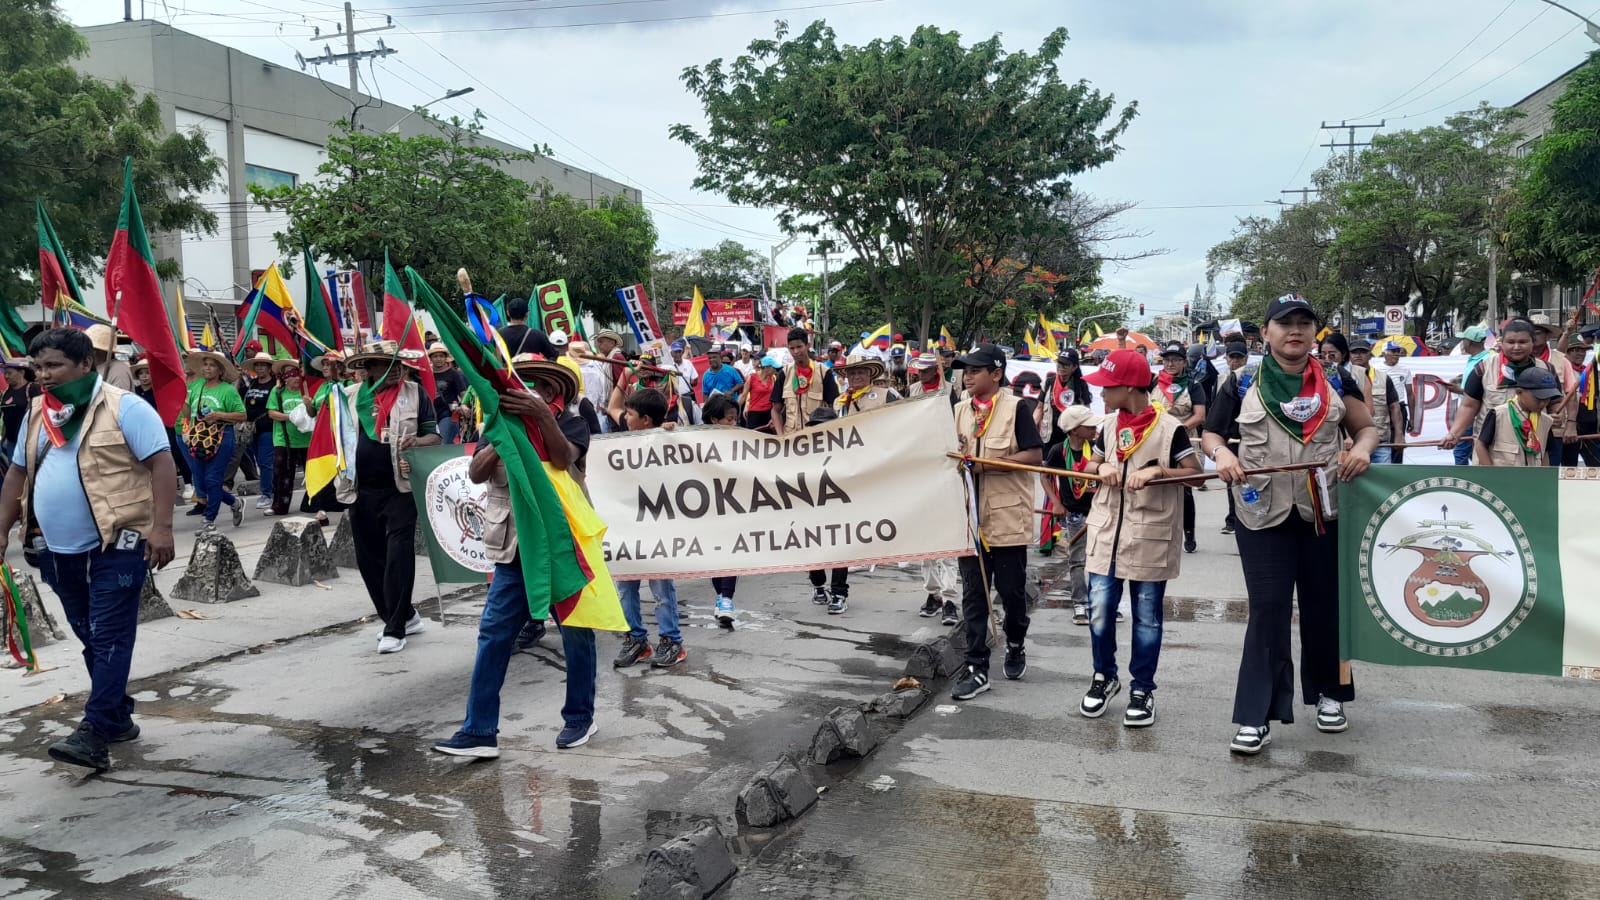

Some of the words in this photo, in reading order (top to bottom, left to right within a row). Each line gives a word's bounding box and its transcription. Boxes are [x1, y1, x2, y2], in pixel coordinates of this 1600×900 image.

[624, 288, 653, 342] UTRAL
[607, 442, 722, 471] GUARDIA
[731, 425, 865, 462] INDIGENA
[436, 473, 462, 512] GUARDIA
[635, 456, 851, 522] MOKANÁ
[602, 537, 704, 561] GALAPA
[731, 518, 897, 554] ATLÁNTICO
